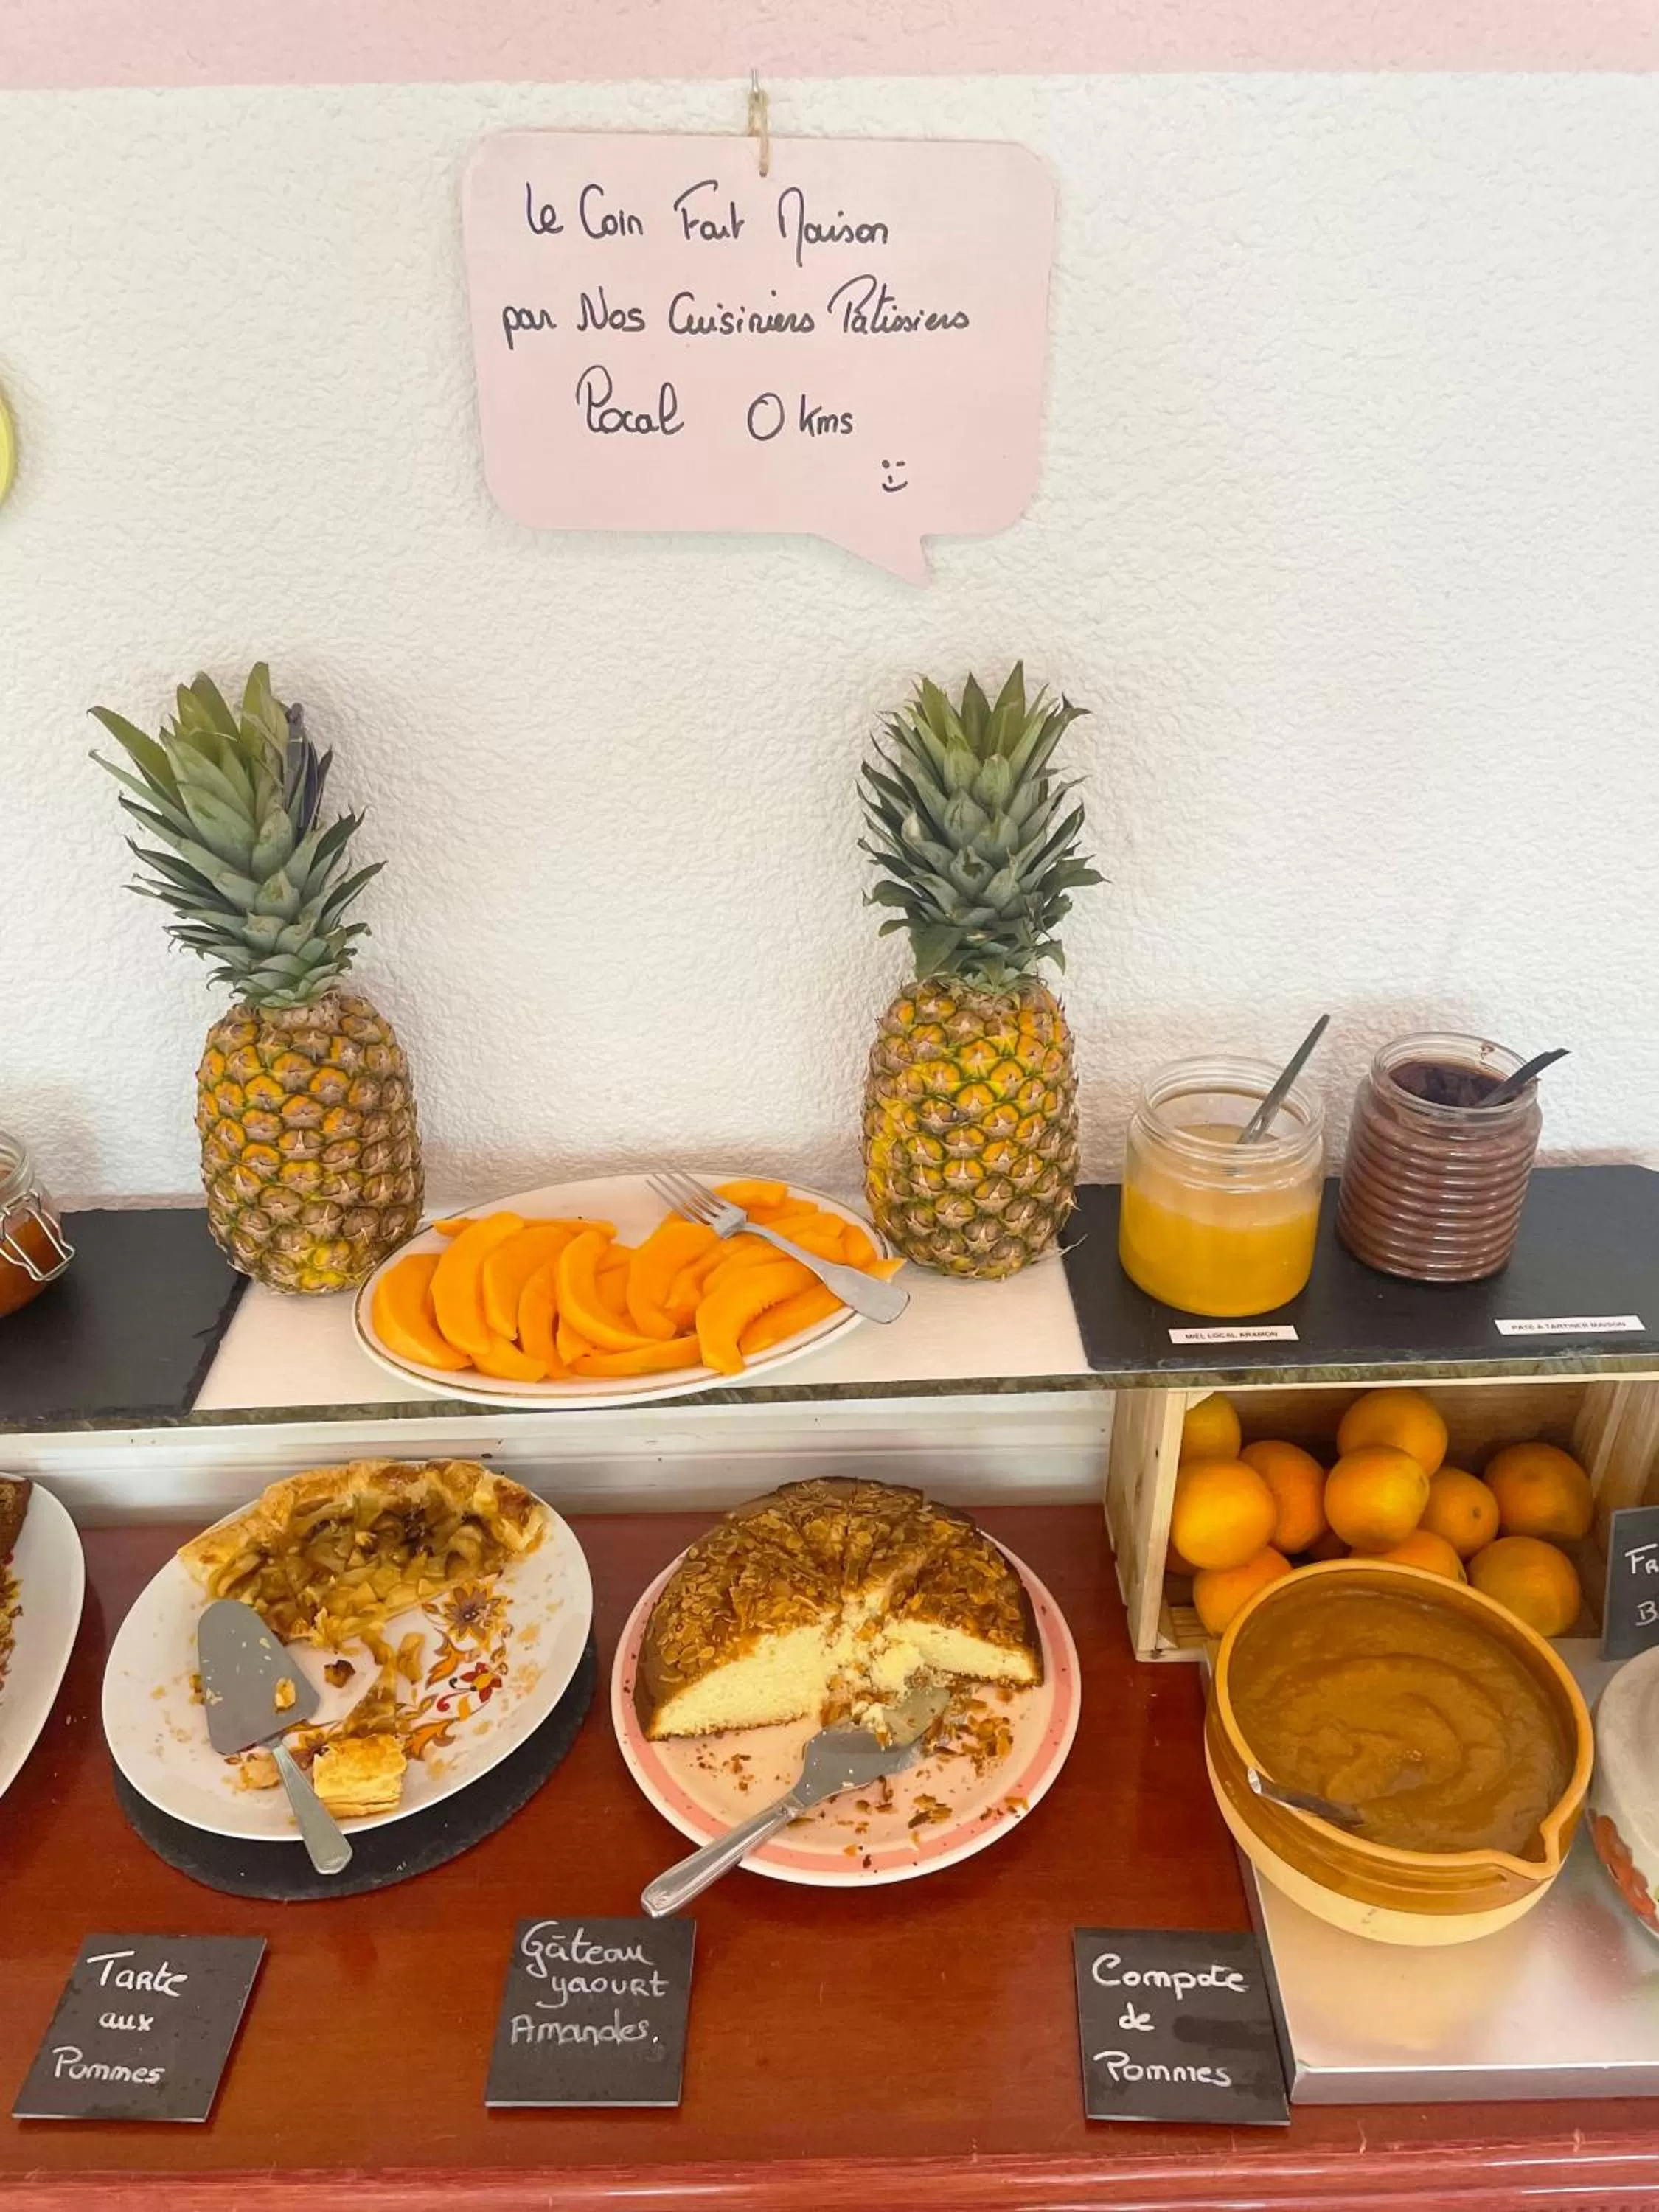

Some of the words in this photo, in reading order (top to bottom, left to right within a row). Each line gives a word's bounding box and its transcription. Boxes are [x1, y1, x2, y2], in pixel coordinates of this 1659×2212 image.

[526, 181, 564, 235] Le
[580, 184, 644, 240] Coin
[674, 179, 745, 240] Fait
[778, 186, 889, 268] Maison
[503, 305, 557, 351] par
[577, 285, 647, 332] Nos
[668, 288, 816, 335] Cuisiniers
[1185, 1332, 1206, 1340] MIEL
[86, 1950, 189, 1997] Tarte
[535, 1969, 670, 2009] yaourt
[1092, 1952, 1250, 2000] Compote
[98, 2012, 154, 2031] aux
[1118, 2001, 1155, 2031] de
[52, 2045, 167, 2084] Pommes
[1092, 2050, 1232, 2087] Pommes
